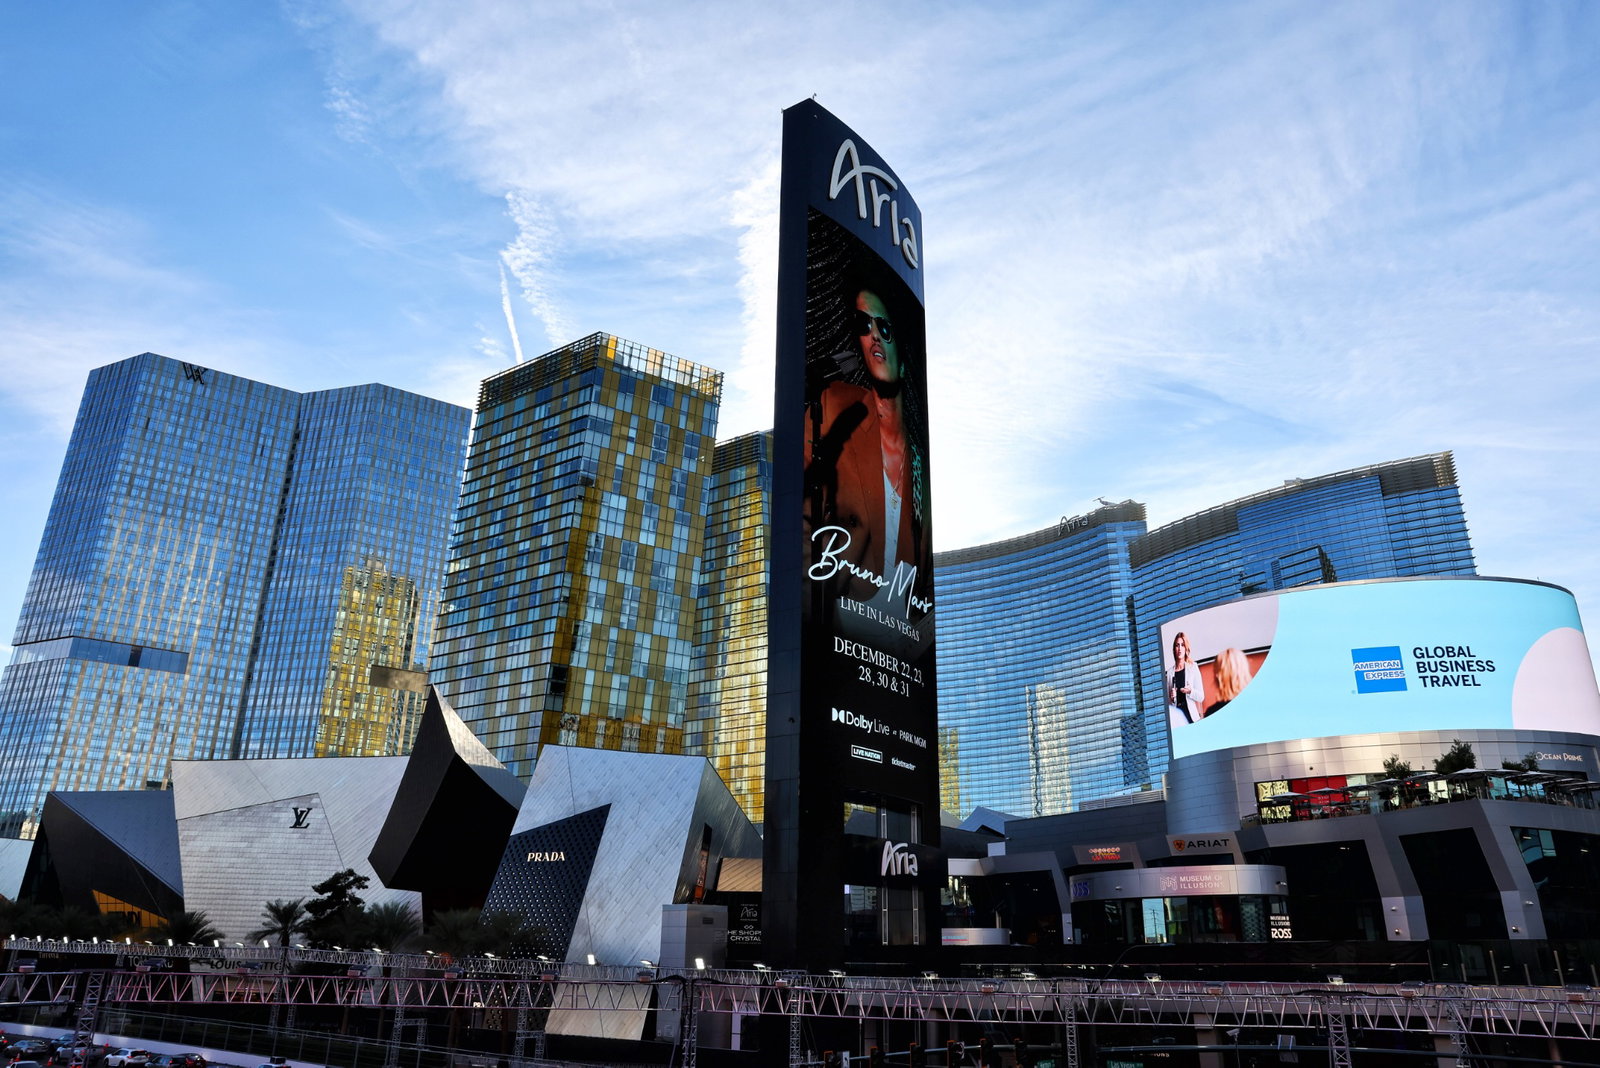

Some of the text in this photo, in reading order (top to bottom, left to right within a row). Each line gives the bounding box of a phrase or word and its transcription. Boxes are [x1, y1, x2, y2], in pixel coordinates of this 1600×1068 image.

[829, 138, 919, 269] Aria
[183, 361, 208, 384] W
[1058, 515, 1088, 536] Aria
[808, 525, 933, 620] Bruno Mars
[840, 596, 920, 642] LIVE IN LAS VEGAS
[1413, 645, 1476, 659] GLOBAL
[834, 636, 925, 688] DECEMBER 22, 23,
[1354, 661, 1400, 670] AMERICAN
[1416, 660, 1496, 673] BUSINESS
[858, 665, 909, 697] 28, 30 & 31
[1365, 671, 1406, 679] EXPRESS
[1419, 674, 1481, 688] TRAVEL
[846, 711, 873, 733] Dolby
[874, 718, 890, 735] Live
[899, 729, 914, 743] PARK
[914, 736, 927, 749] MGM
[853, 748, 881, 760] LIVE NATION
[1536, 751, 1584, 762] OCEAN PRIME
[1187, 839, 1230, 848] ARIAT
[527, 851, 565, 862] PRADA
[881, 841, 918, 877] Aria
[1180, 874, 1211, 883] MUSEUM
[741, 907, 758, 918] Aria
[1271, 928, 1292, 938] ROSS
[210, 961, 242, 969] LOUIS
